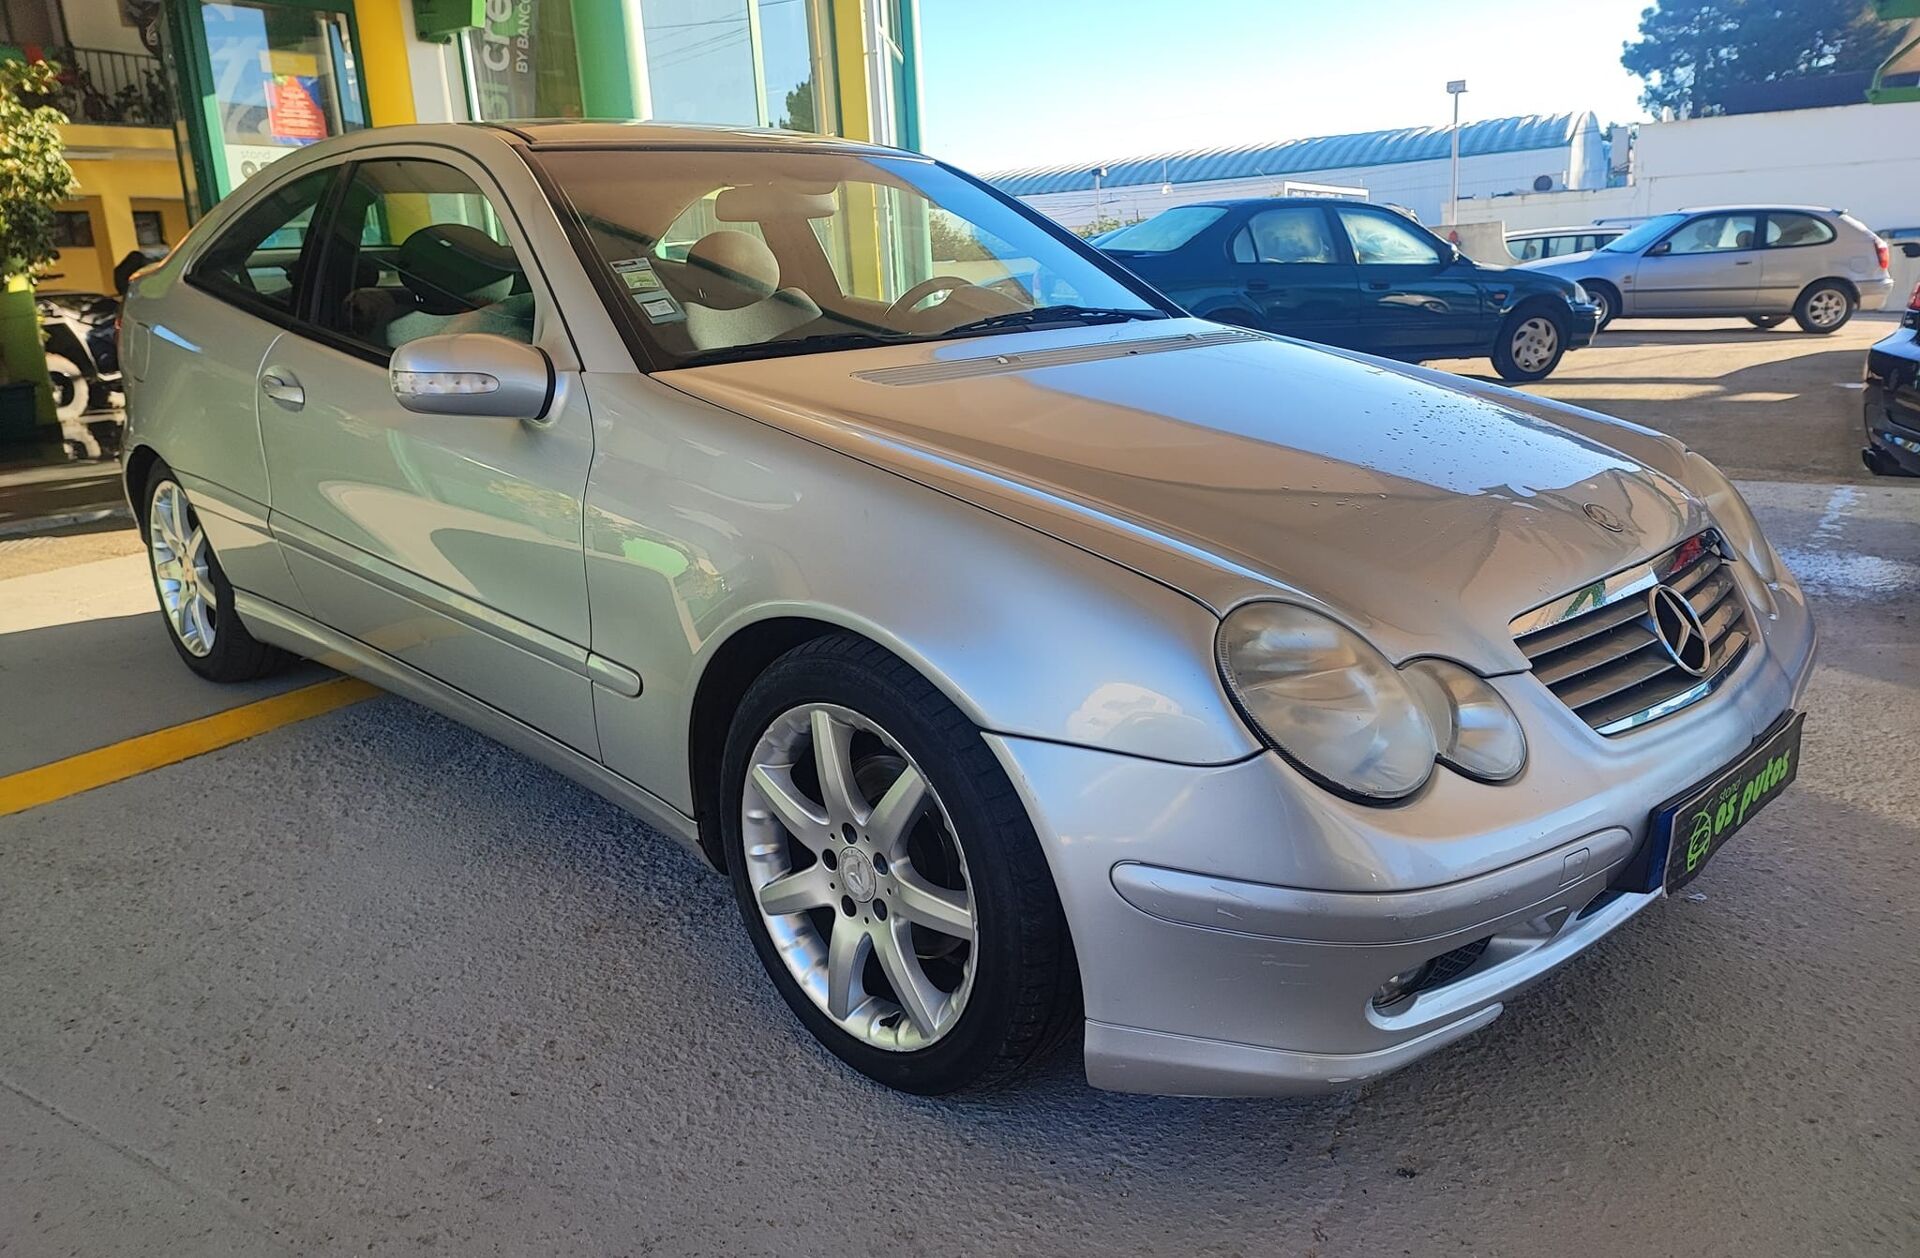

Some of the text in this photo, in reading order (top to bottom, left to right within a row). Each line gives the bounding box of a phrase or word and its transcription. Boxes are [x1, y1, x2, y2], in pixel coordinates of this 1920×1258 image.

[516, 49, 529, 73] BY
[241, 160, 274, 178] o
[1715, 748, 1790, 834] os putos
